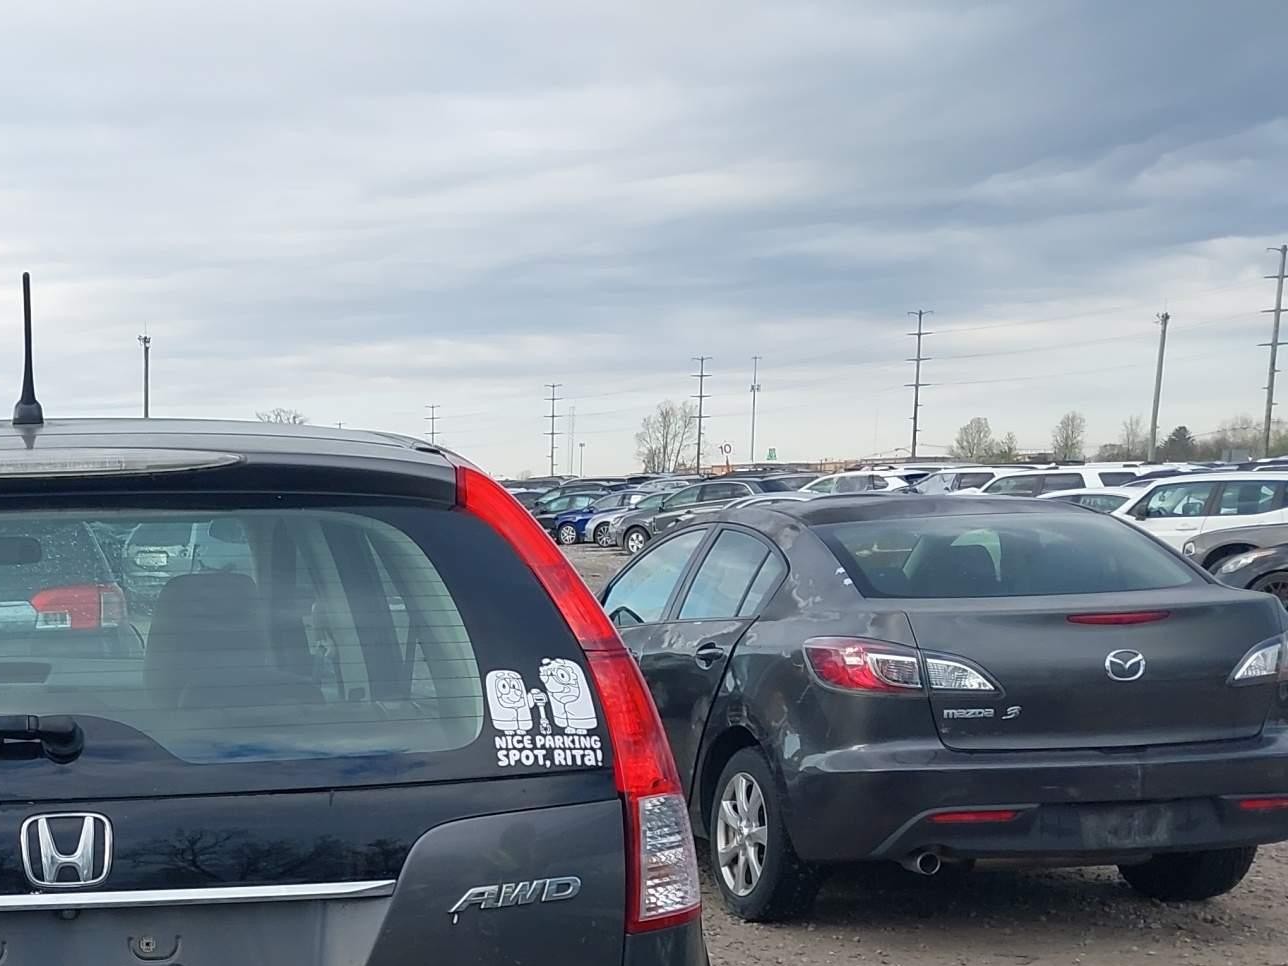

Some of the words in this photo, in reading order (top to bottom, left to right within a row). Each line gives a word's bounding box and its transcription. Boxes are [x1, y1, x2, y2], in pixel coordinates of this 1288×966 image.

[718, 443, 732, 455] 10
[494, 735, 533, 749] NICE
[535, 735, 601, 749] PARKING
[497, 750, 551, 768] SPOT,
[449, 876, 581, 912] AWD
